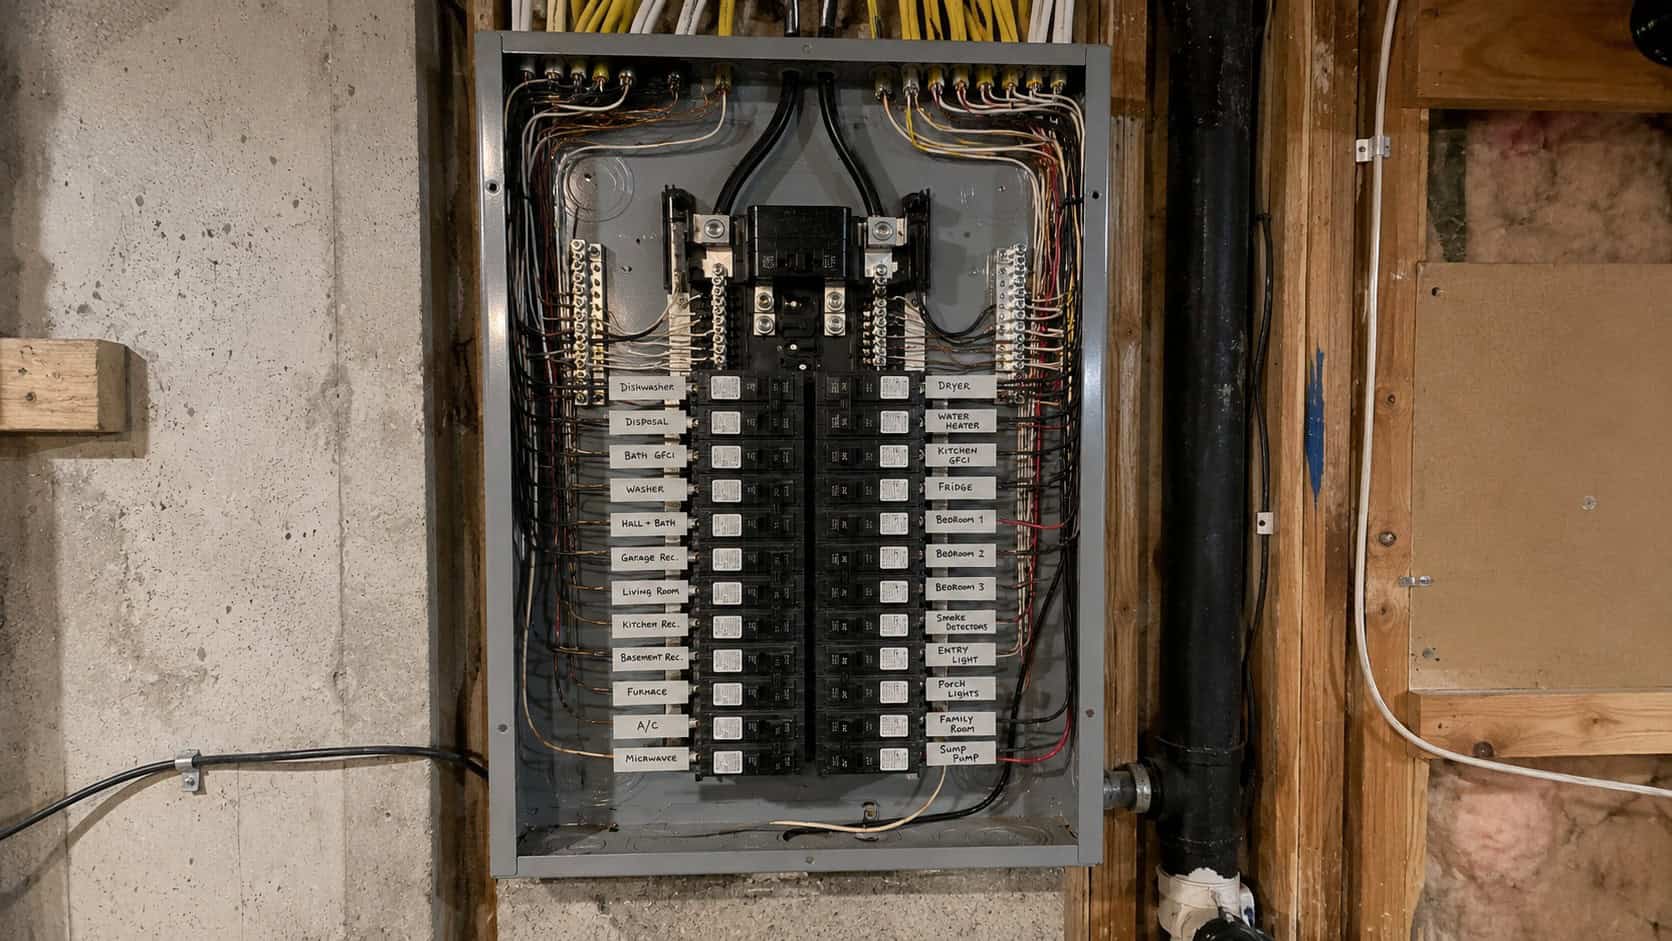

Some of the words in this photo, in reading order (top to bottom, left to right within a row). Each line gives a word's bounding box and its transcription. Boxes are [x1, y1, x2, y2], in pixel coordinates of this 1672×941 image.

[938, 413, 969, 421] WATER
[946, 422, 980, 430] HEATER
[624, 451, 648, 461] BATH
[654, 450, 675, 460] GFCI
[938, 447, 978, 455] KITCHEN
[949, 456, 970, 465] GFCI
[626, 485, 664, 494] WASHER
[939, 482, 973, 492] FRIDGE
[622, 519, 643, 528] HALL
[654, 518, 676, 528] BATH
[978, 515, 984, 524] 1
[978, 549, 985, 558] 2
[978, 582, 985, 591] 3
[938, 646, 969, 655] ENTRY
[952, 656, 979, 665] LIGHT
[637, 720, 659, 733] A/C
